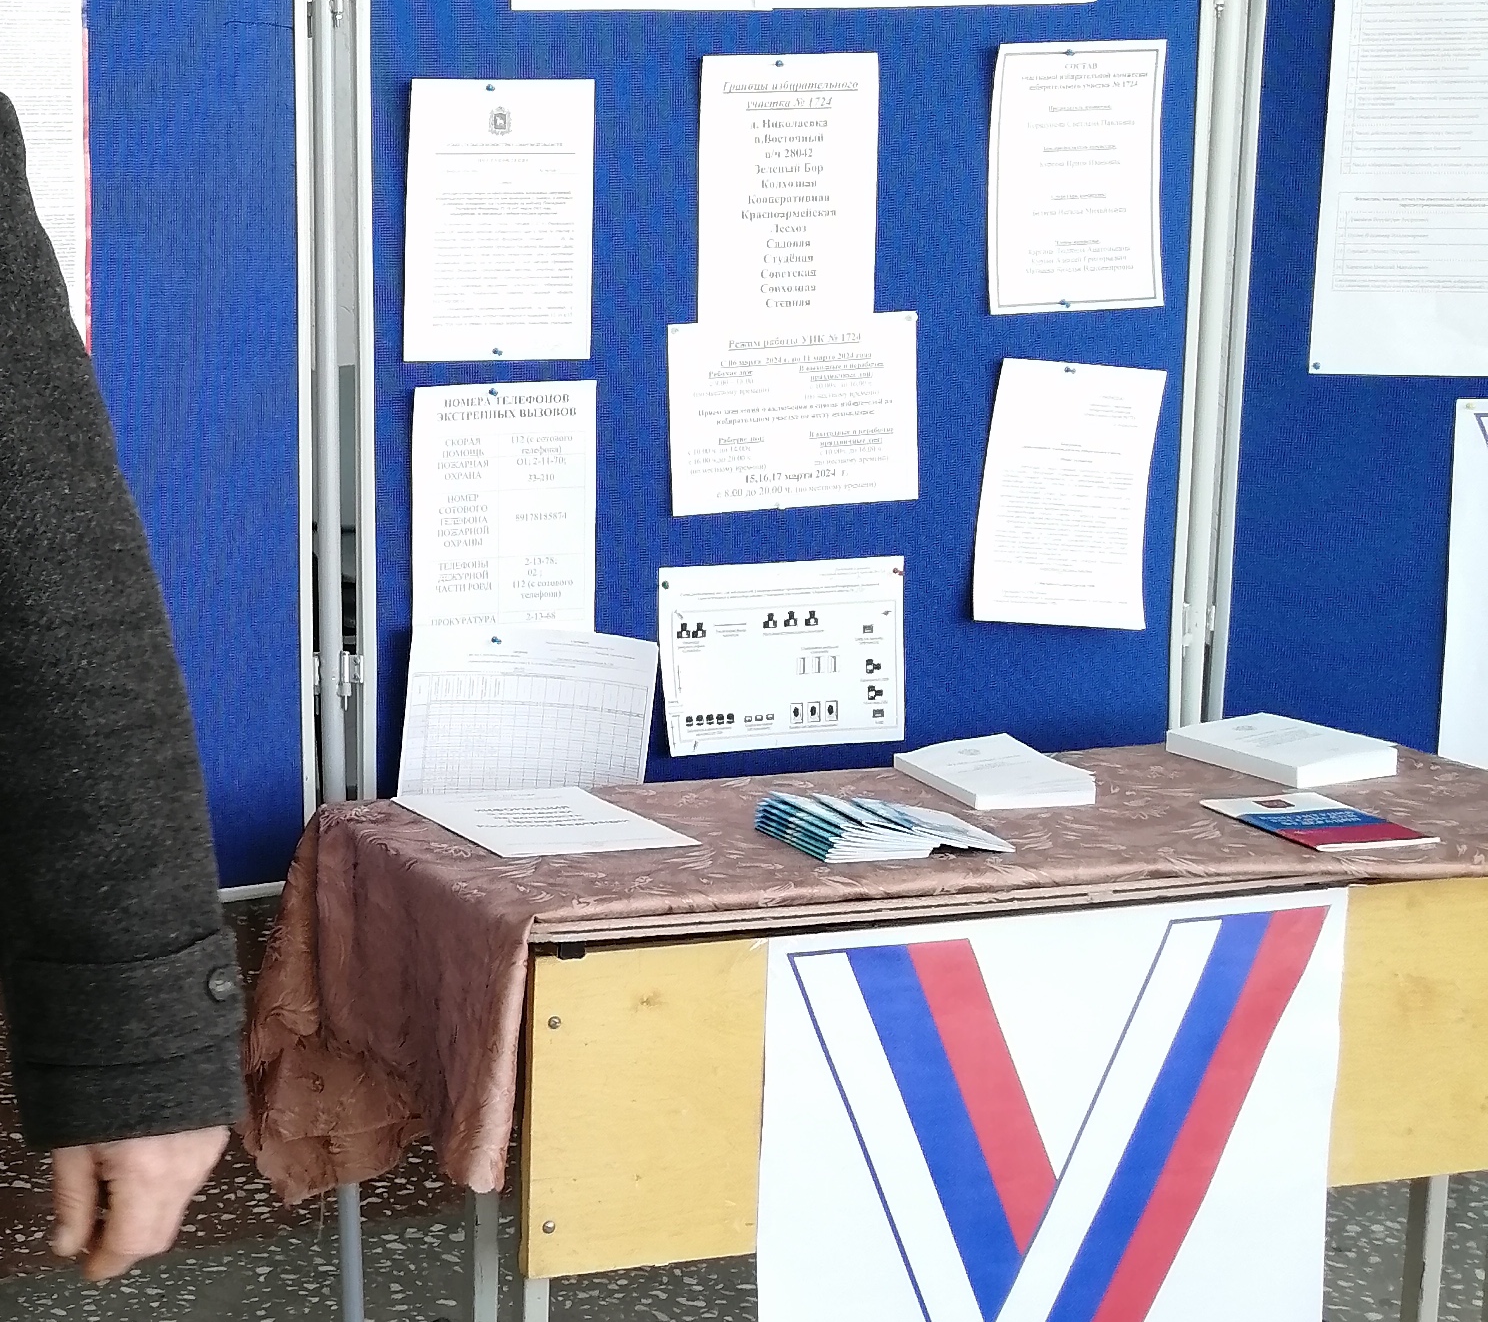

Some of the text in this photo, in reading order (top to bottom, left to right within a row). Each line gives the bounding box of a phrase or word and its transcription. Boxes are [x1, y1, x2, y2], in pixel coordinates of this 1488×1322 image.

[762, 119, 828, 129] Николаевка
[804, 162, 824, 175] Бор
[741, 209, 837, 222] Красноармейская
[770, 223, 807, 234] Лесхоз
[766, 238, 811, 249] Садовая
[760, 269, 817, 279] Советская
[760, 283, 817, 294] Совхозная
[765, 298, 811, 309] Степная
[444, 393, 570, 408] НОМЕРА ТЕЛЕФОНОВ
[437, 407, 577, 422] ЭКСТРЕННЫХ ВЫЗОВОВ
[445, 437, 481, 447] СКОРАЯ
[442, 449, 485, 459] ПОМОЩЬ
[437, 460, 489, 470] ПОЖАРНАЯ
[444, 471, 482, 481] ОХРАНА
[815, 468, 836, 479] 2024
[447, 493, 479, 504] НОМЕР
[438, 504, 488, 515] СОТОВОГО
[437, 525, 489, 538] ПОЖАРНОЙ
[443, 538, 483, 548] ОХРАНЫ
[438, 560, 489, 571] ТЕЛЕФОНЫ
[435, 583, 466, 594] ЧАСТИ
[431, 614, 496, 627] ПРОКУРАТУРА
